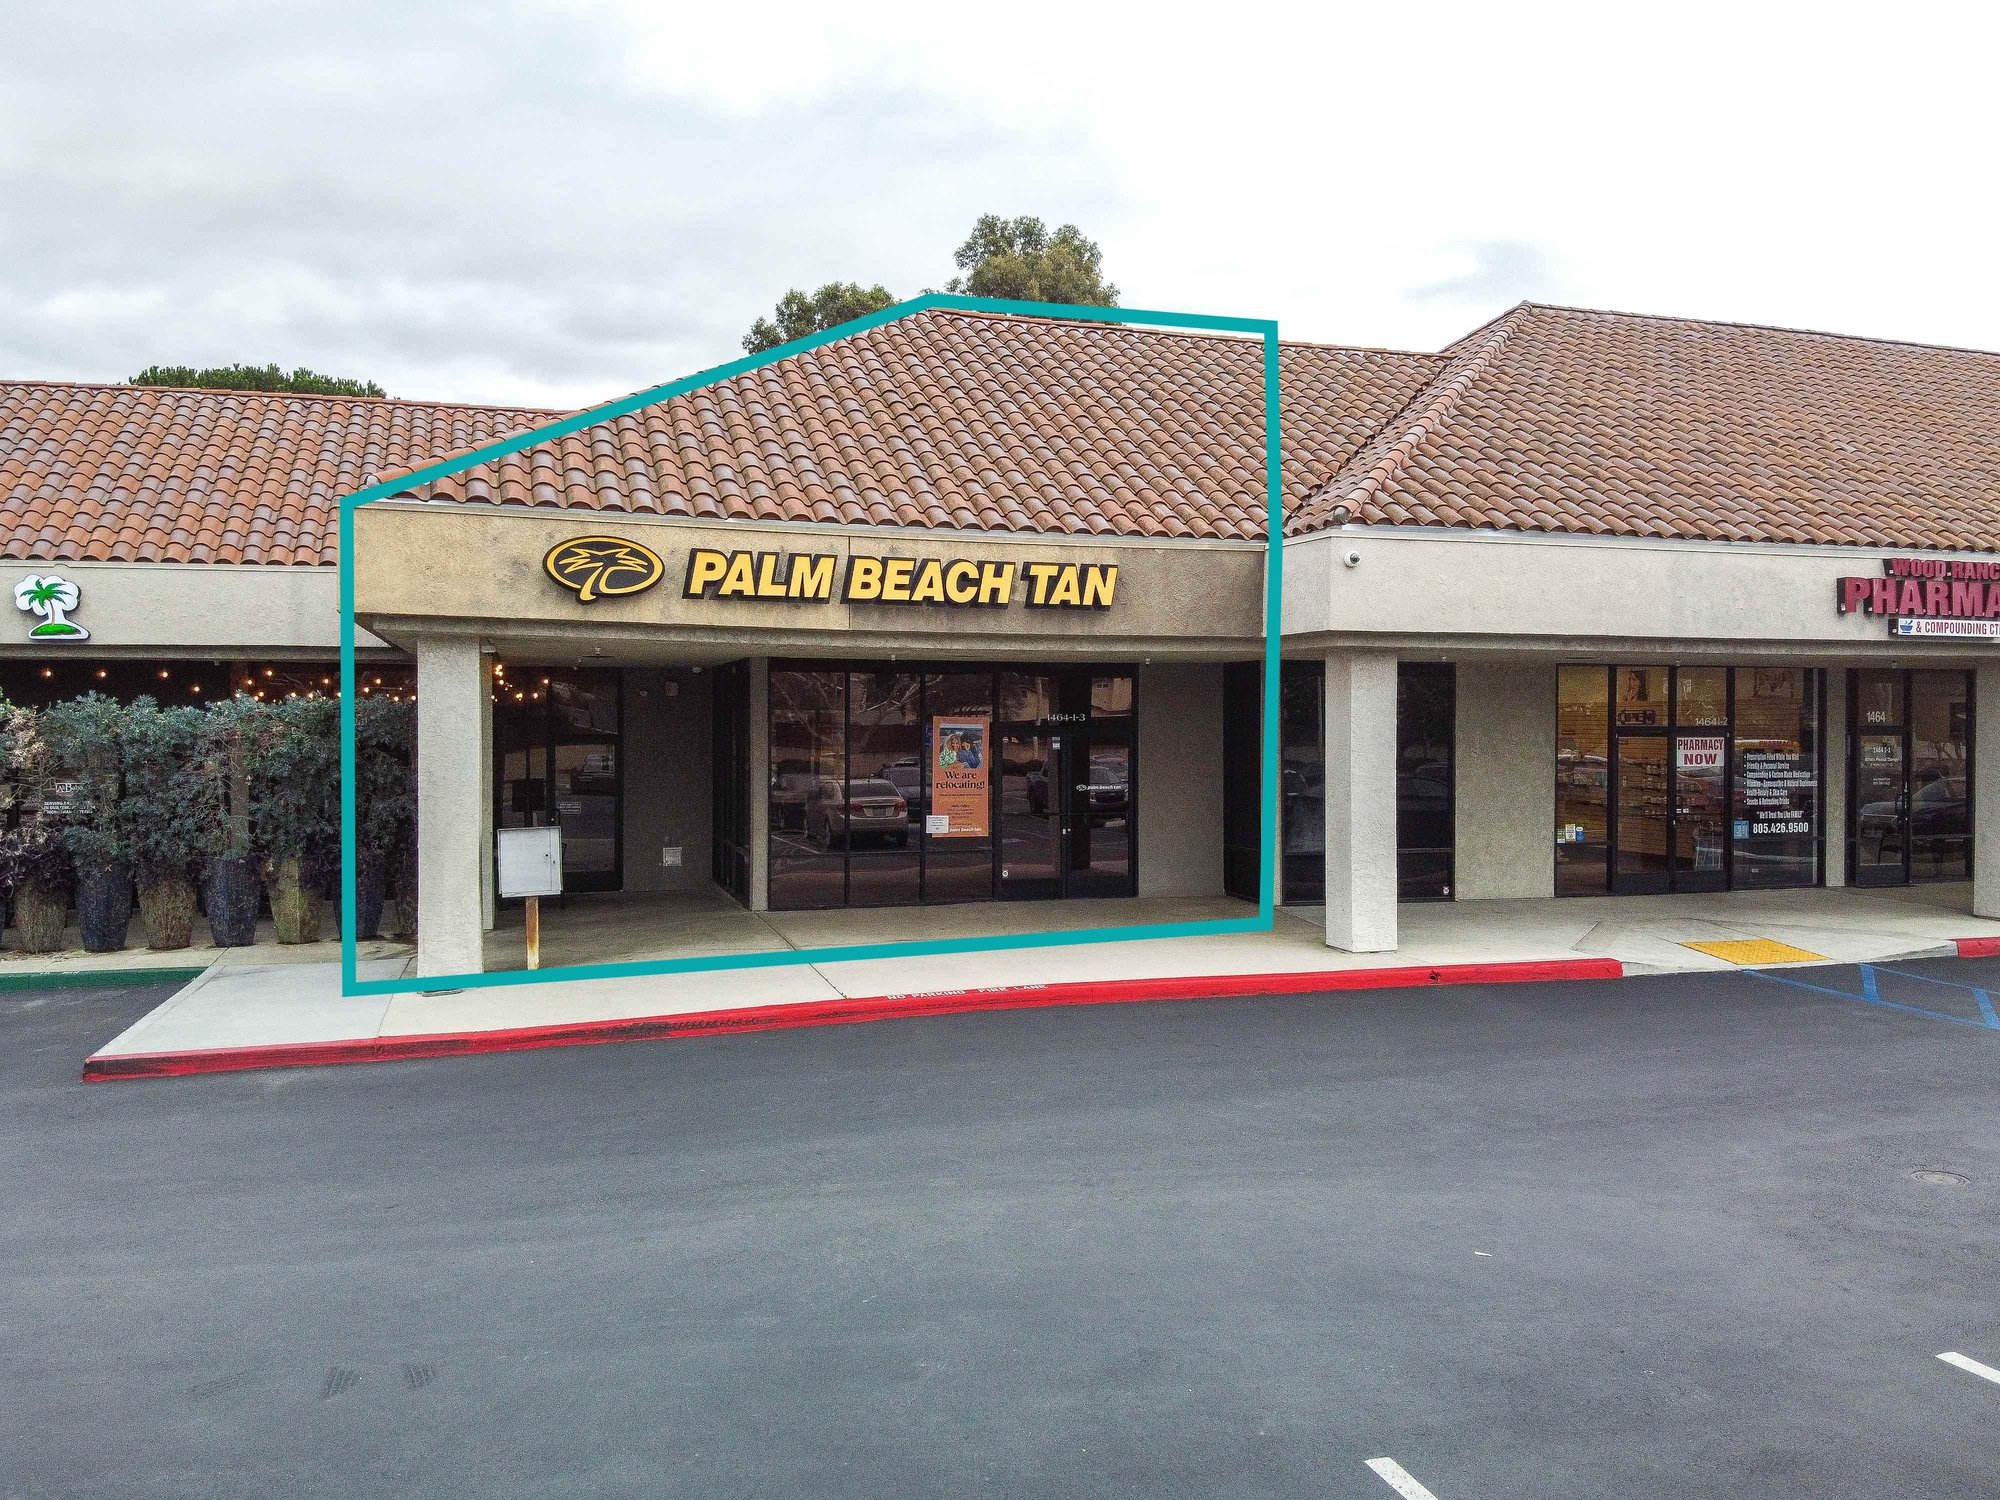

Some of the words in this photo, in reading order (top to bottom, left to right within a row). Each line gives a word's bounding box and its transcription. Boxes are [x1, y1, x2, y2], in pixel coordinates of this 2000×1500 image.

[1890, 558, 1946, 578] WOOD
[1951, 561, 2000, 579] RANC
[684, 549, 838, 603] PALM
[843, 556, 1014, 606] BEACH
[1023, 562, 1118, 609] TAN
[1843, 577, 2000, 617] PHARMA
[1915, 621, 1922, 633] &
[1924, 621, 1987, 635] COMPOUNDING
[1866, 711, 1886, 722] 1464
[1678, 739, 1724, 751] PHARMACY
[1683, 753, 1718, 766] NOW
[944, 771, 960, 780] We
[936, 780, 985, 790] relocating!
[1752, 822, 1809, 834] 805.426.9500
[911, 990, 966, 999] PARKING
